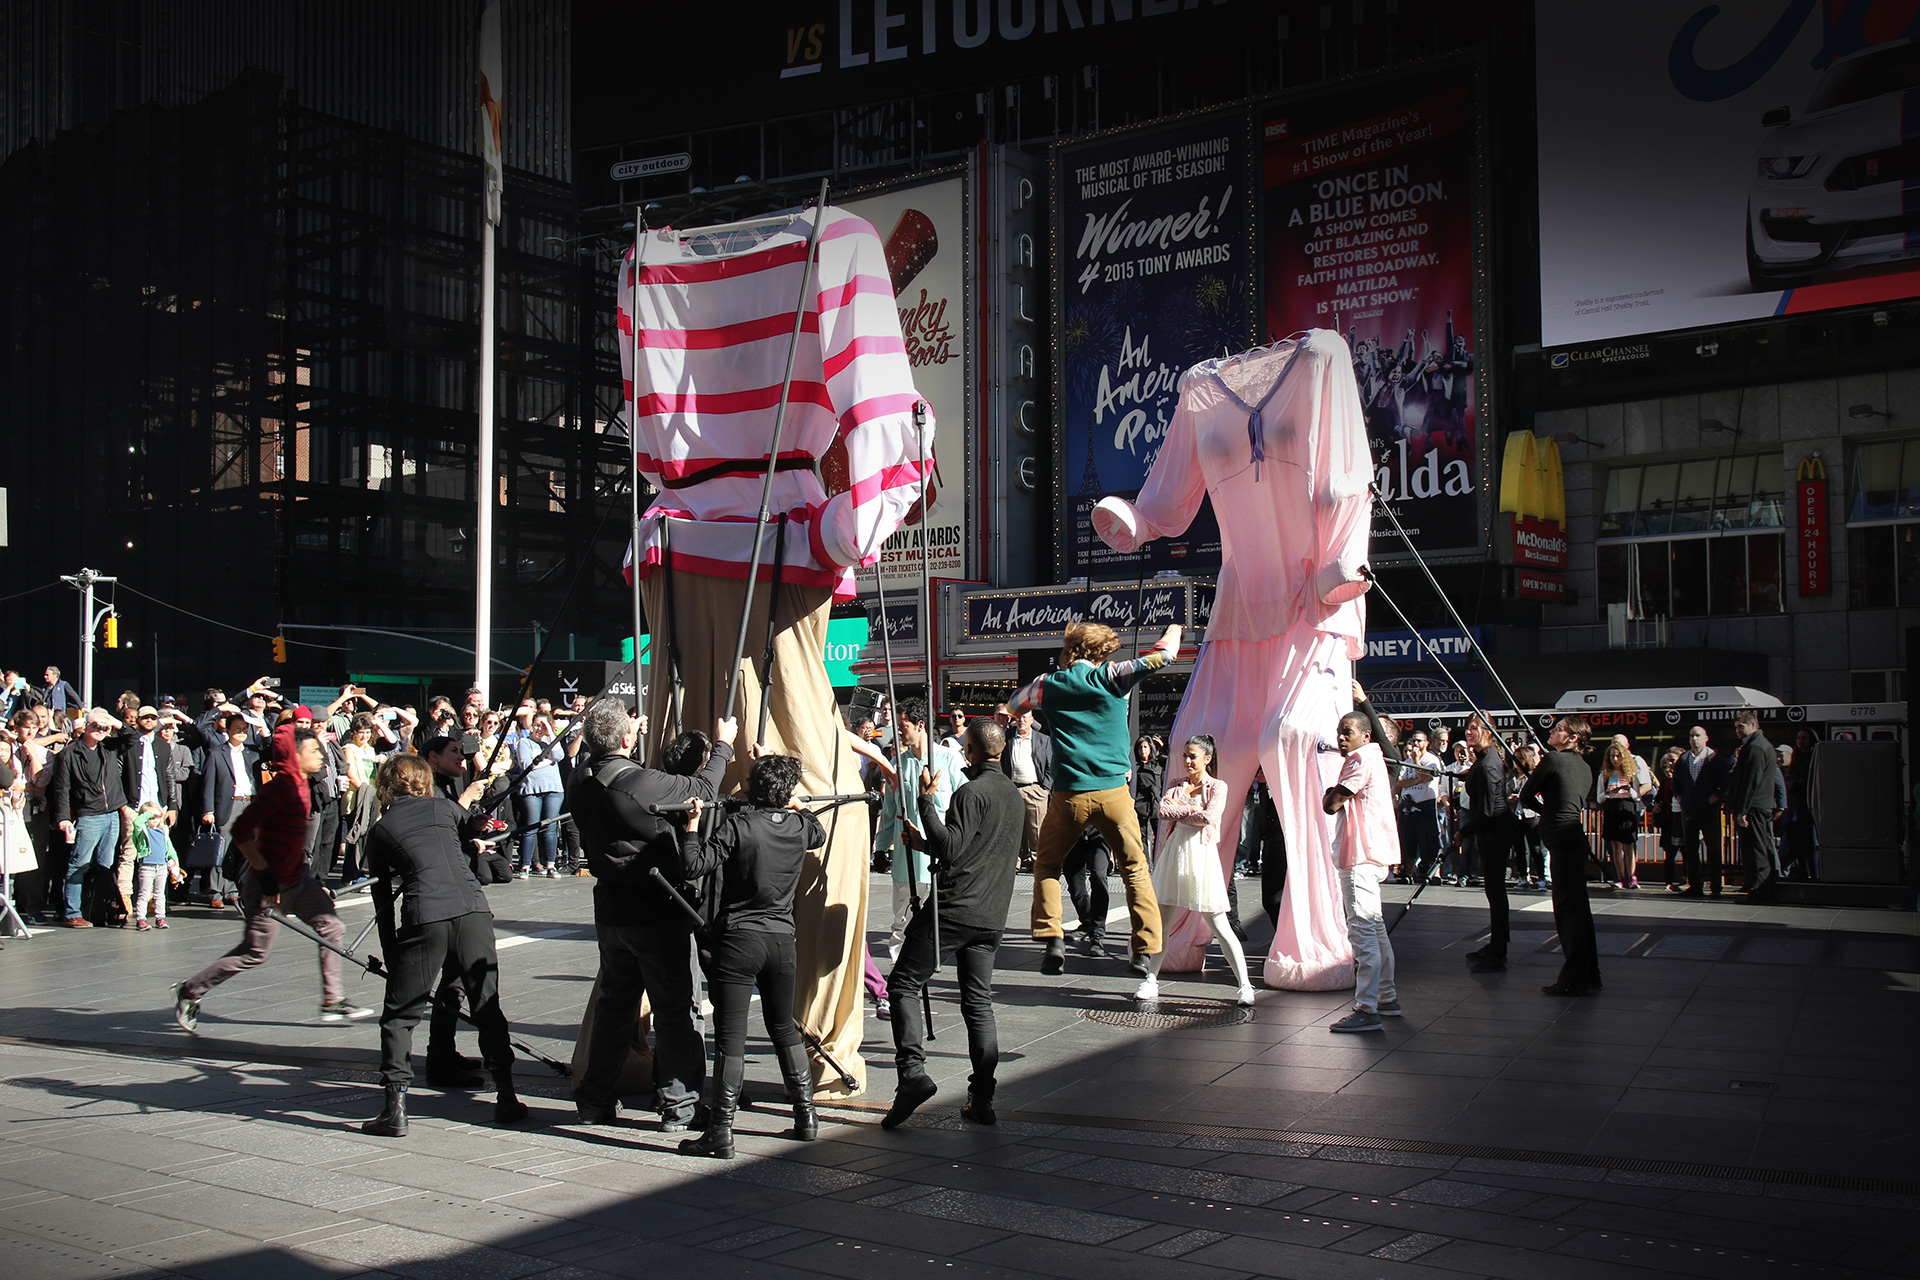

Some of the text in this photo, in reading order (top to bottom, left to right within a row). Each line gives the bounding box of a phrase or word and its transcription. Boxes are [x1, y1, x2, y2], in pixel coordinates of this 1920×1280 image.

[786, 23, 826, 64] VS
[1264, 122, 1287, 137] RSC
[1301, 110, 1420, 155] TIME Magazine’s
[1075, 136, 1230, 184] THE MOST AWARD-WINNING
[1292, 122, 1433, 176] #1 Show of the Year!
[618, 158, 685, 175] city outdoor
[1081, 155, 1226, 200] MUSICAL OF THE SEASON!
[1385, 164, 1409, 188] IN
[1287, 180, 1449, 228] A BLUE MOON,
[1076, 184, 1233, 260] Winner!
[1313, 208, 1418, 239] A SHOW COMES
[1303, 222, 1429, 255] OUT BLAZING AND
[1313, 240, 1419, 269] RESTORES YOUR
[1077, 243, 1231, 295] 4 2015 TONY AWARDS
[1297, 252, 1440, 287] FAITH IN BROADWAY.
[1335, 275, 1398, 296] MATILDA
[897, 288, 950, 342] nky
[1316, 301, 1328, 314] IS
[1331, 295, 1368, 312] THAT
[1017, 177, 1036, 489] PALACE
[1116, 324, 1152, 378] An
[1601, 352, 1650, 364] SPECTACOLOR
[1113, 408, 1172, 457] Par
[1369, 438, 1385, 448] hl’s
[1372, 438, 1476, 503] ilda
[1516, 530, 1567, 553] McDonald’s
[1803, 487, 1820, 589] OPEN 24 HOURS
[881, 546, 961, 563] EST MUSICAL
[1525, 549, 1559, 563] Restaurant
[1522, 579, 1539, 590] OPEN
[1540, 581, 1547, 590] 24
[1152, 590, 1172, 606] New
[980, 602, 1002, 632] An
[1005, 598, 1083, 633] American
[1090, 593, 1136, 627] Paris
[1143, 605, 1176, 625] Musical
[824, 641, 860, 661] ton
[1426, 637, 1472, 655] ATM
[1367, 691, 1466, 703] ONEY EXCHANGE
[1497, 718, 1514, 726] NOV
[1571, 711, 1650, 727] EGENDS
[1763, 708, 1777, 718] PM
[1789, 710, 1803, 718] TNT
[1850, 707, 1876, 716] 6778
